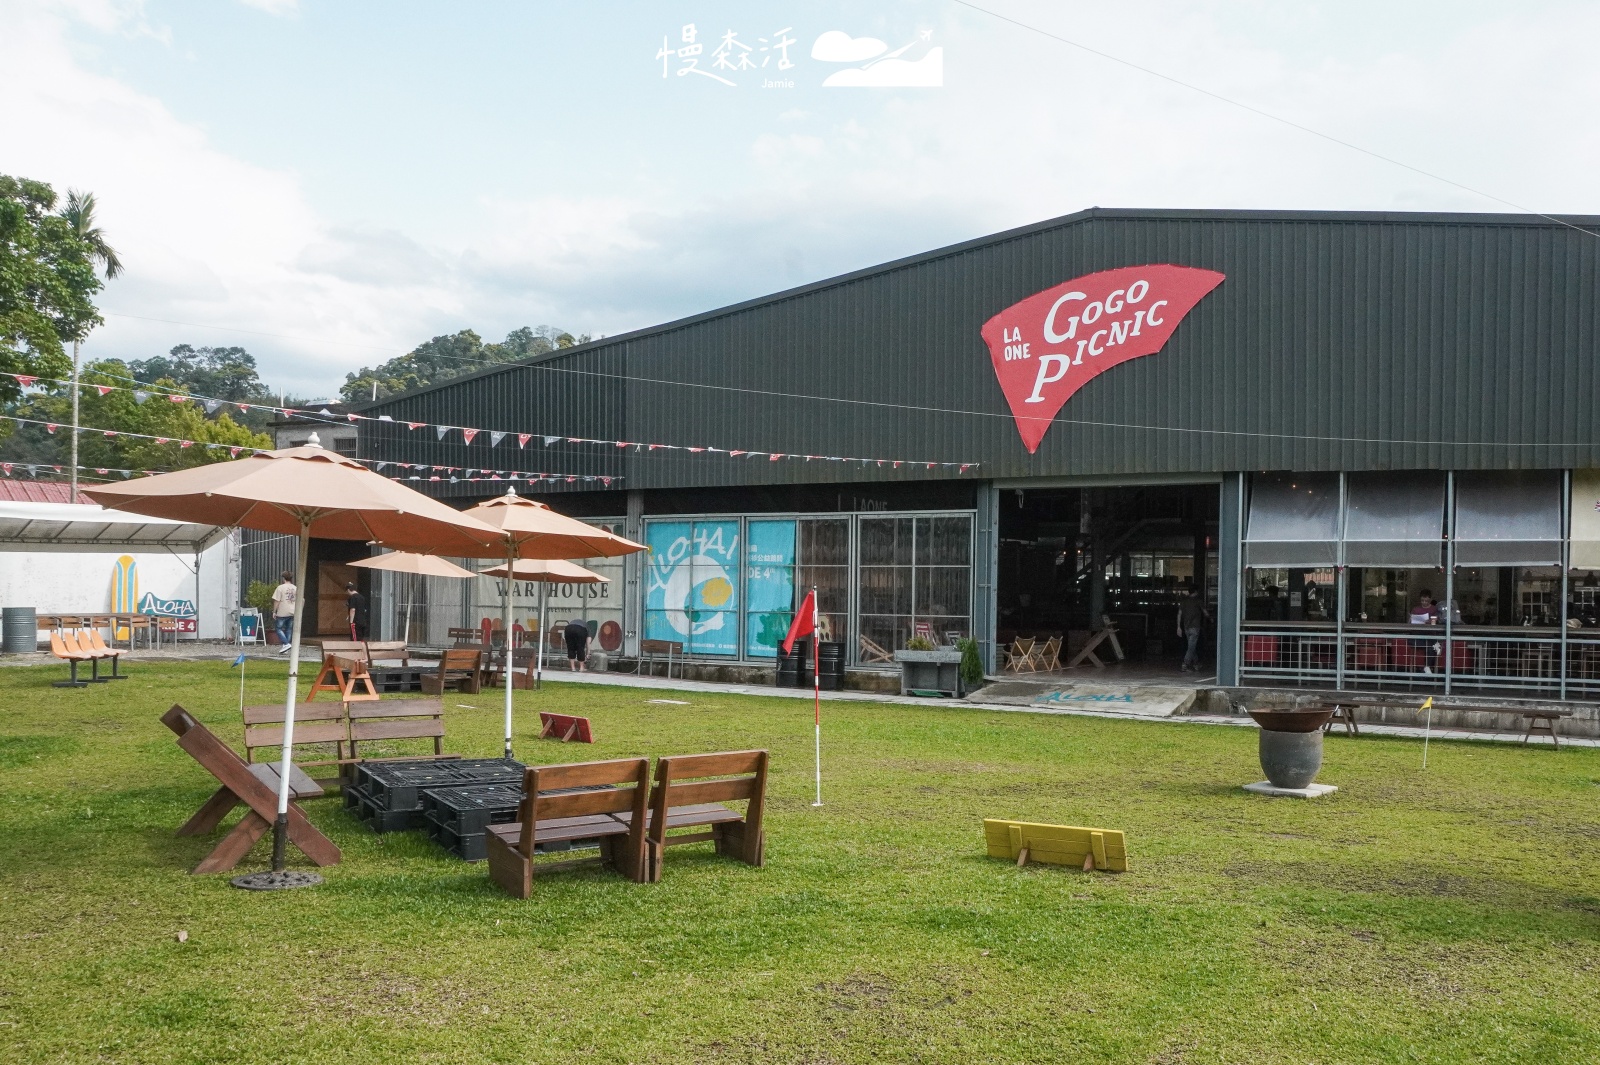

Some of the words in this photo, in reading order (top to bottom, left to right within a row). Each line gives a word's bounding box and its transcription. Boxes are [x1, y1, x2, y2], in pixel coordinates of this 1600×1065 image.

[1003, 326, 1022, 343] LA
[1004, 343, 1031, 361] ONE
[1024, 300, 1167, 403] PICNIC
[496, 582, 609, 598] WARHOUSE
[142, 593, 195, 616] ALOHA
[187, 621, 195, 630] 4
